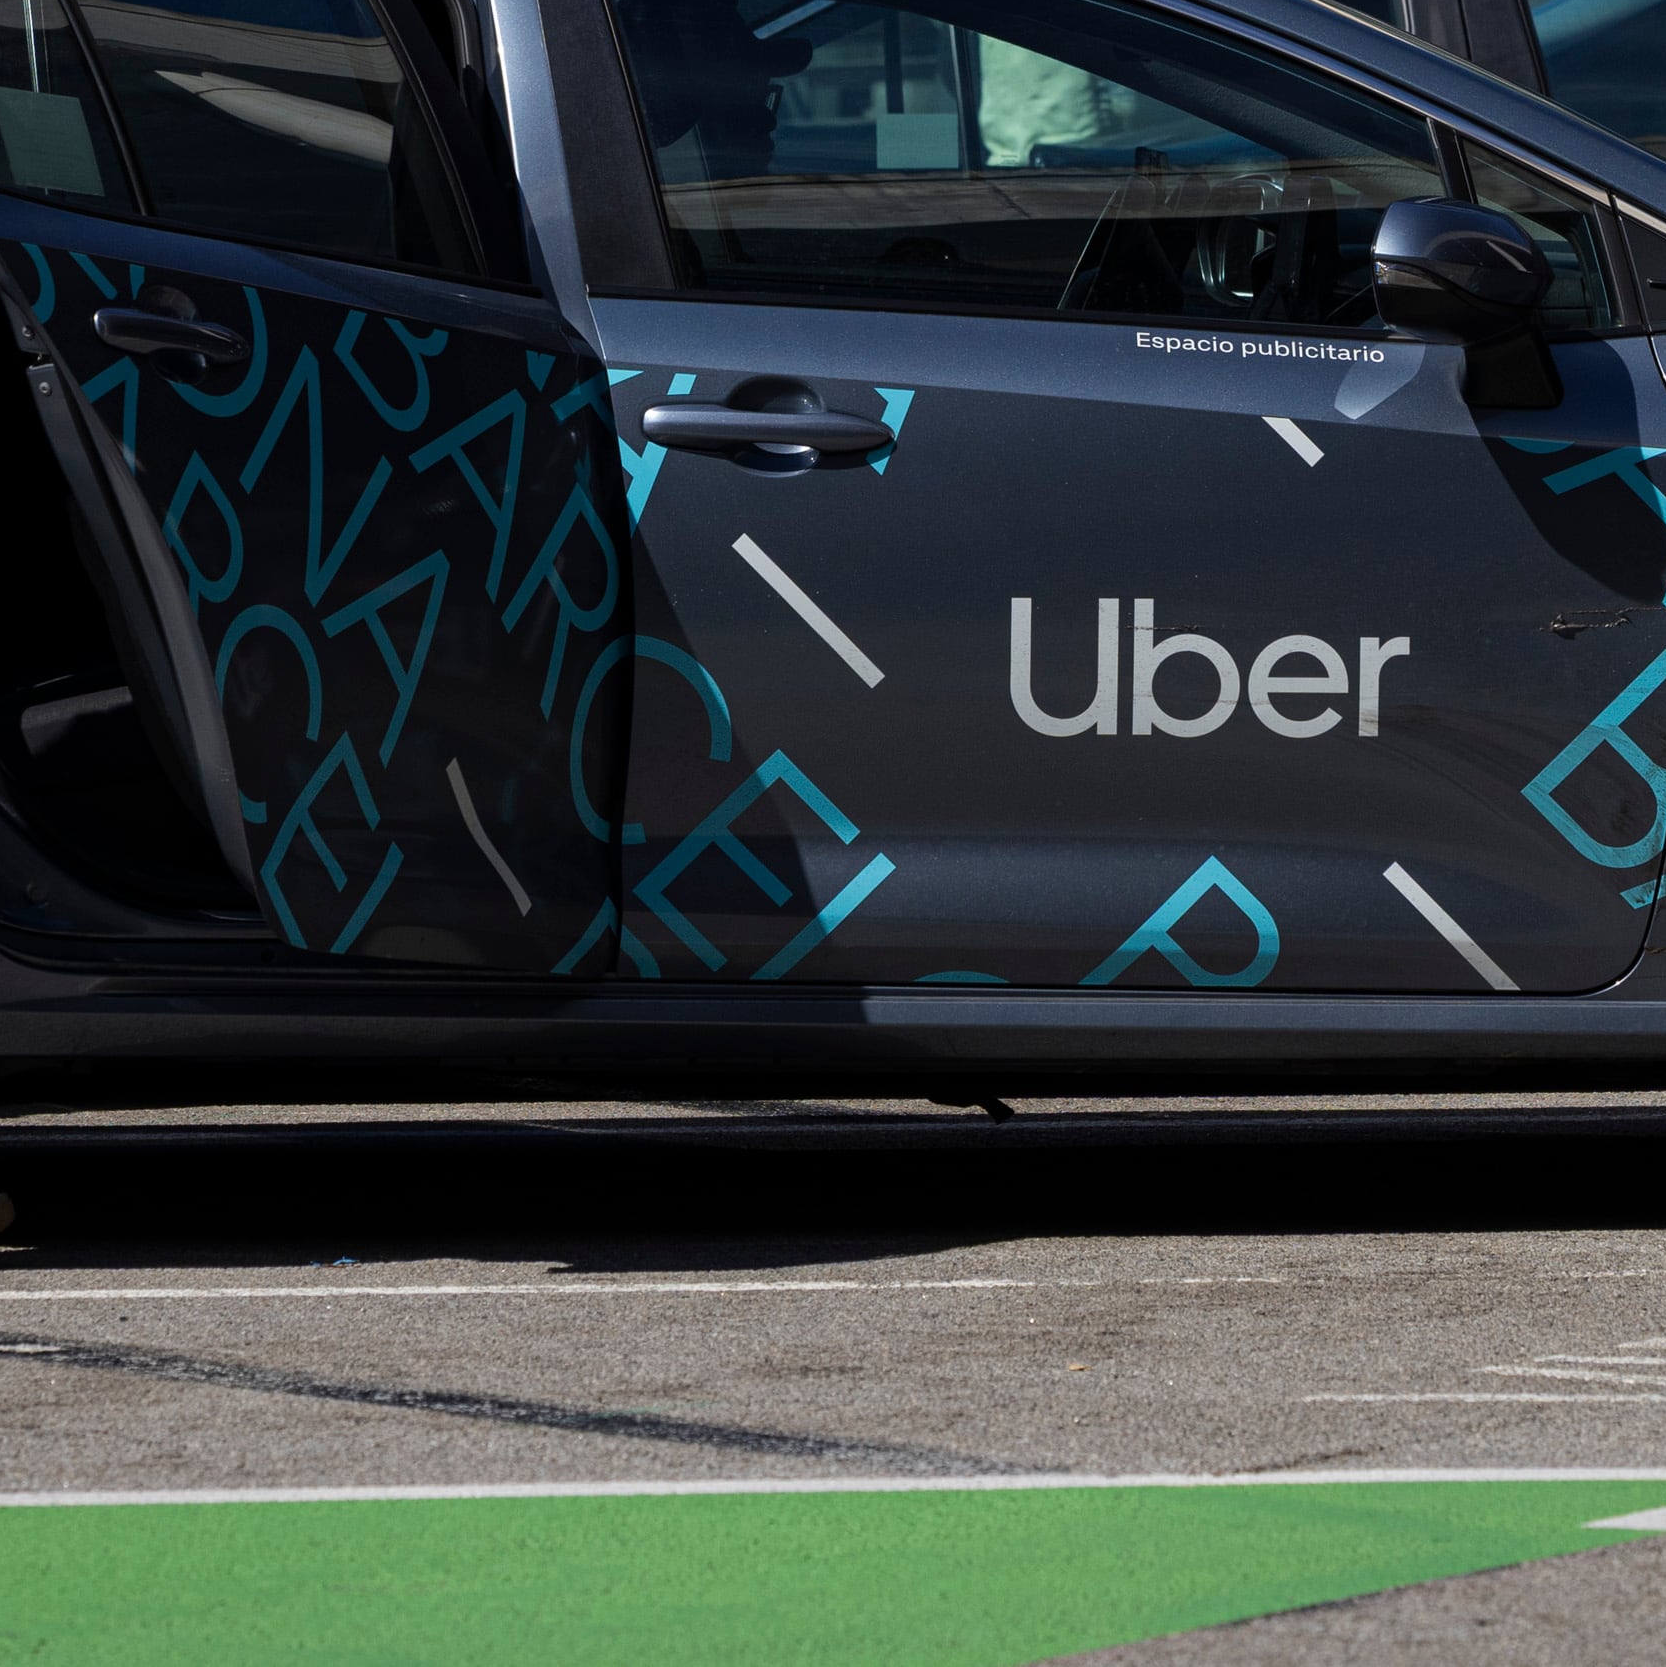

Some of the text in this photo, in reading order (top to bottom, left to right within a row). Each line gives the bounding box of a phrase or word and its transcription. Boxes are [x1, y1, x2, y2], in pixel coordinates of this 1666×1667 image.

[1135, 331, 1385, 364] Espacio publicitario
[1009, 596, 1411, 739] Uber
